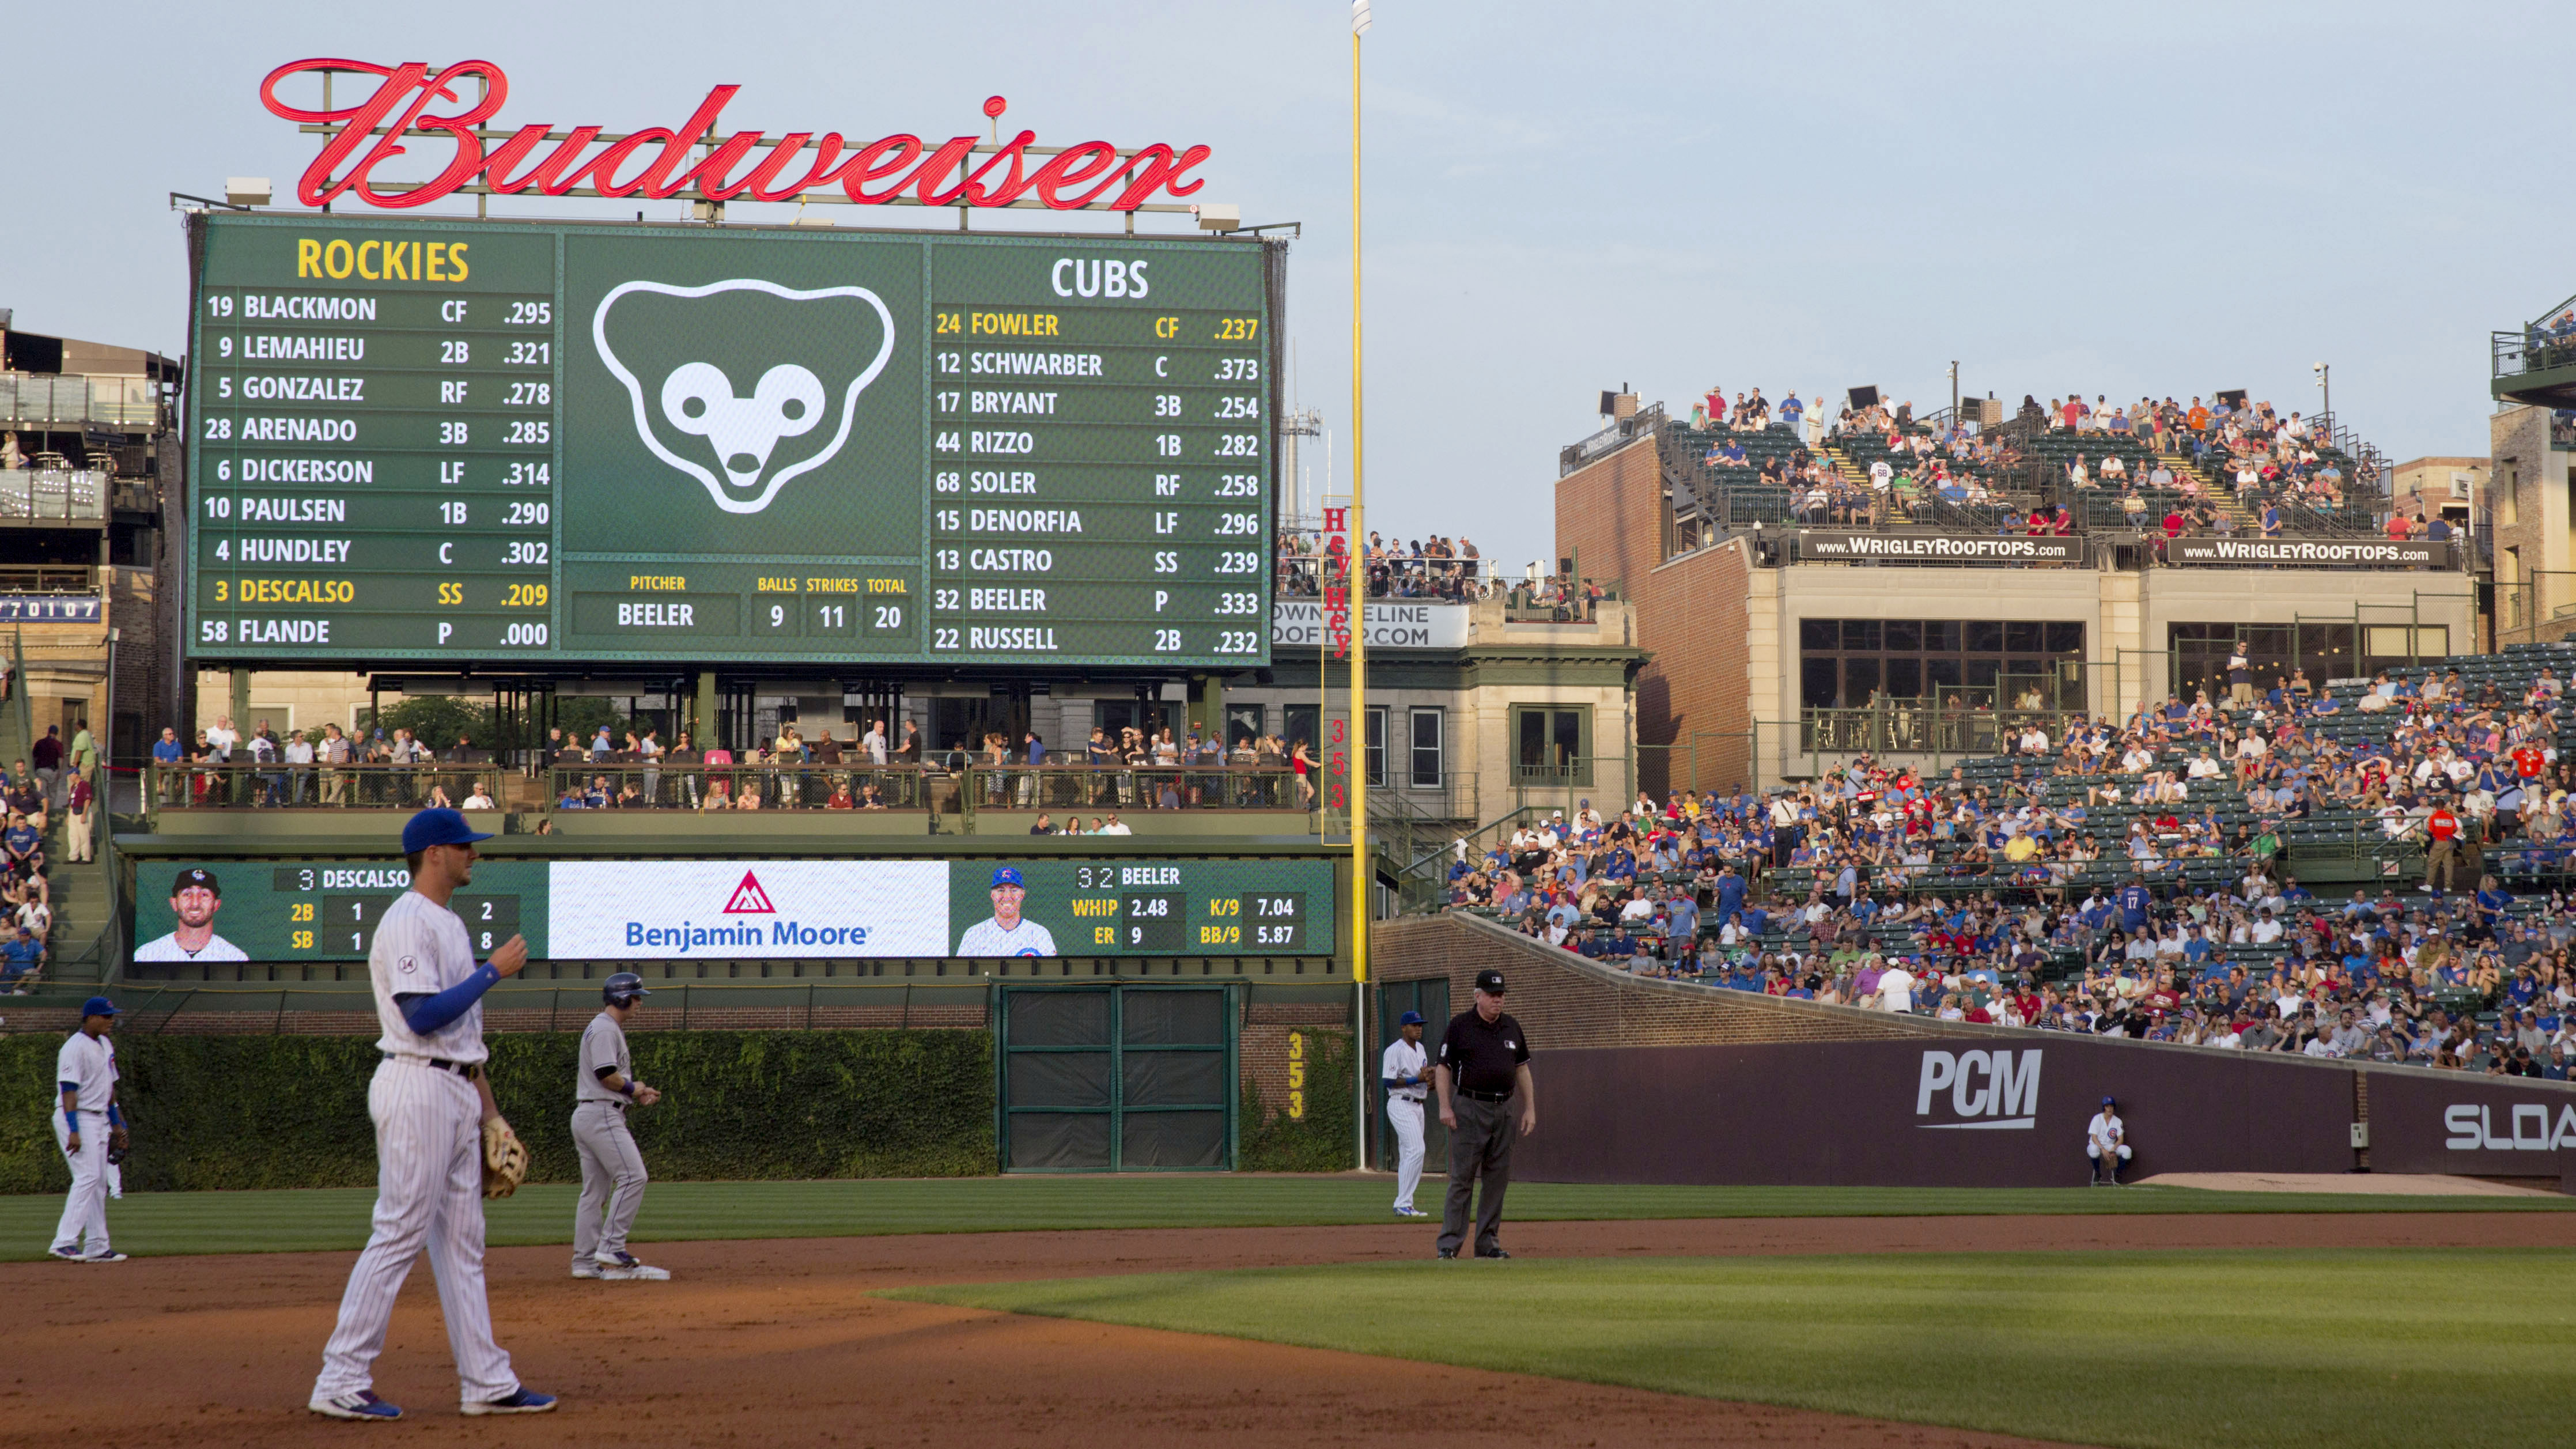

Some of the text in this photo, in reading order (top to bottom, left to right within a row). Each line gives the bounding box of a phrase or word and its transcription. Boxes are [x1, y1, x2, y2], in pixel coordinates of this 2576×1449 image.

[260, 58, 1212, 211] Budweiser
[298, 239, 469, 282] ROCKIES
[1052, 258, 1149, 298] CUBS
[208, 296, 551, 324] 19 BLACKMON CF .295
[937, 312, 1258, 340] 24 FOWLER CF .237
[220, 336, 549, 364] 9 LEMAHIEU 2B .321
[937, 351, 1258, 380] 12 SCHWARBER C .373
[220, 376, 550, 405] 5 GONZALEZ RF .278
[937, 391, 1259, 419] 17 BRYANT 3B .254
[206, 418, 550, 444] 28 ARENADO 3B .285
[936, 431, 1258, 456] 44 RIZZO 1B .282
[218, 459, 550, 485] 6 DICKERSON LF .314
[936, 471, 1258, 496] 68 SOLER RF .258
[1877, 469, 1887, 477] 68
[205, 497, 549, 524] 10 PAULSEN 1B .290
[936, 509, 1258, 535] 15 DENORFIA LF .296
[215, 539, 549, 564] 4 HUNDLEY C .302
[936, 548, 1258, 573] 13 CASTRO SS .239
[215, 580, 548, 606] 3 DESCALSO SS .209
[631, 576, 686, 591] PITCHER
[758, 577, 797, 592] BALLS
[807, 578, 858, 592] STRIKES
[867, 578, 907, 593] TOTAL
[1323, 508, 1352, 658] Hey Hey
[935, 588, 1258, 614] 32 BEELER P .333
[618, 603, 694, 626] BEELER
[771, 605, 784, 627] 9
[820, 606, 843, 627] 11
[875, 606, 901, 628] 20
[202, 619, 548, 645] 58 FLANDE P .000
[935, 627, 1257, 653] 22 RUSSELL 2B .232
[1331, 719, 1345, 808] 353
[299, 869, 410, 891] 3 DESCALSO
[1078, 867, 1181, 888] 32 BEELER
[292, 902, 361, 921] 2B 1
[482, 902, 493, 920] 2
[1072, 899, 1168, 917] WHIP 2.48
[1211, 898, 1294, 916] K/9 7.04
[2128, 896, 2138, 909] 17
[292, 930, 361, 951] SB 1
[481, 932, 493, 949] 8
[626, 921, 763, 953] Benjamin
[1095, 926, 1142, 944] ER 9
[1201, 926, 1293, 944] BB/9 5.87
[402, 958, 414, 970] 14
[1289, 1032, 1303, 1118] 353
[1916, 1049, 2043, 1117] PCM
[2445, 1103, 2576, 1151] SLOA
